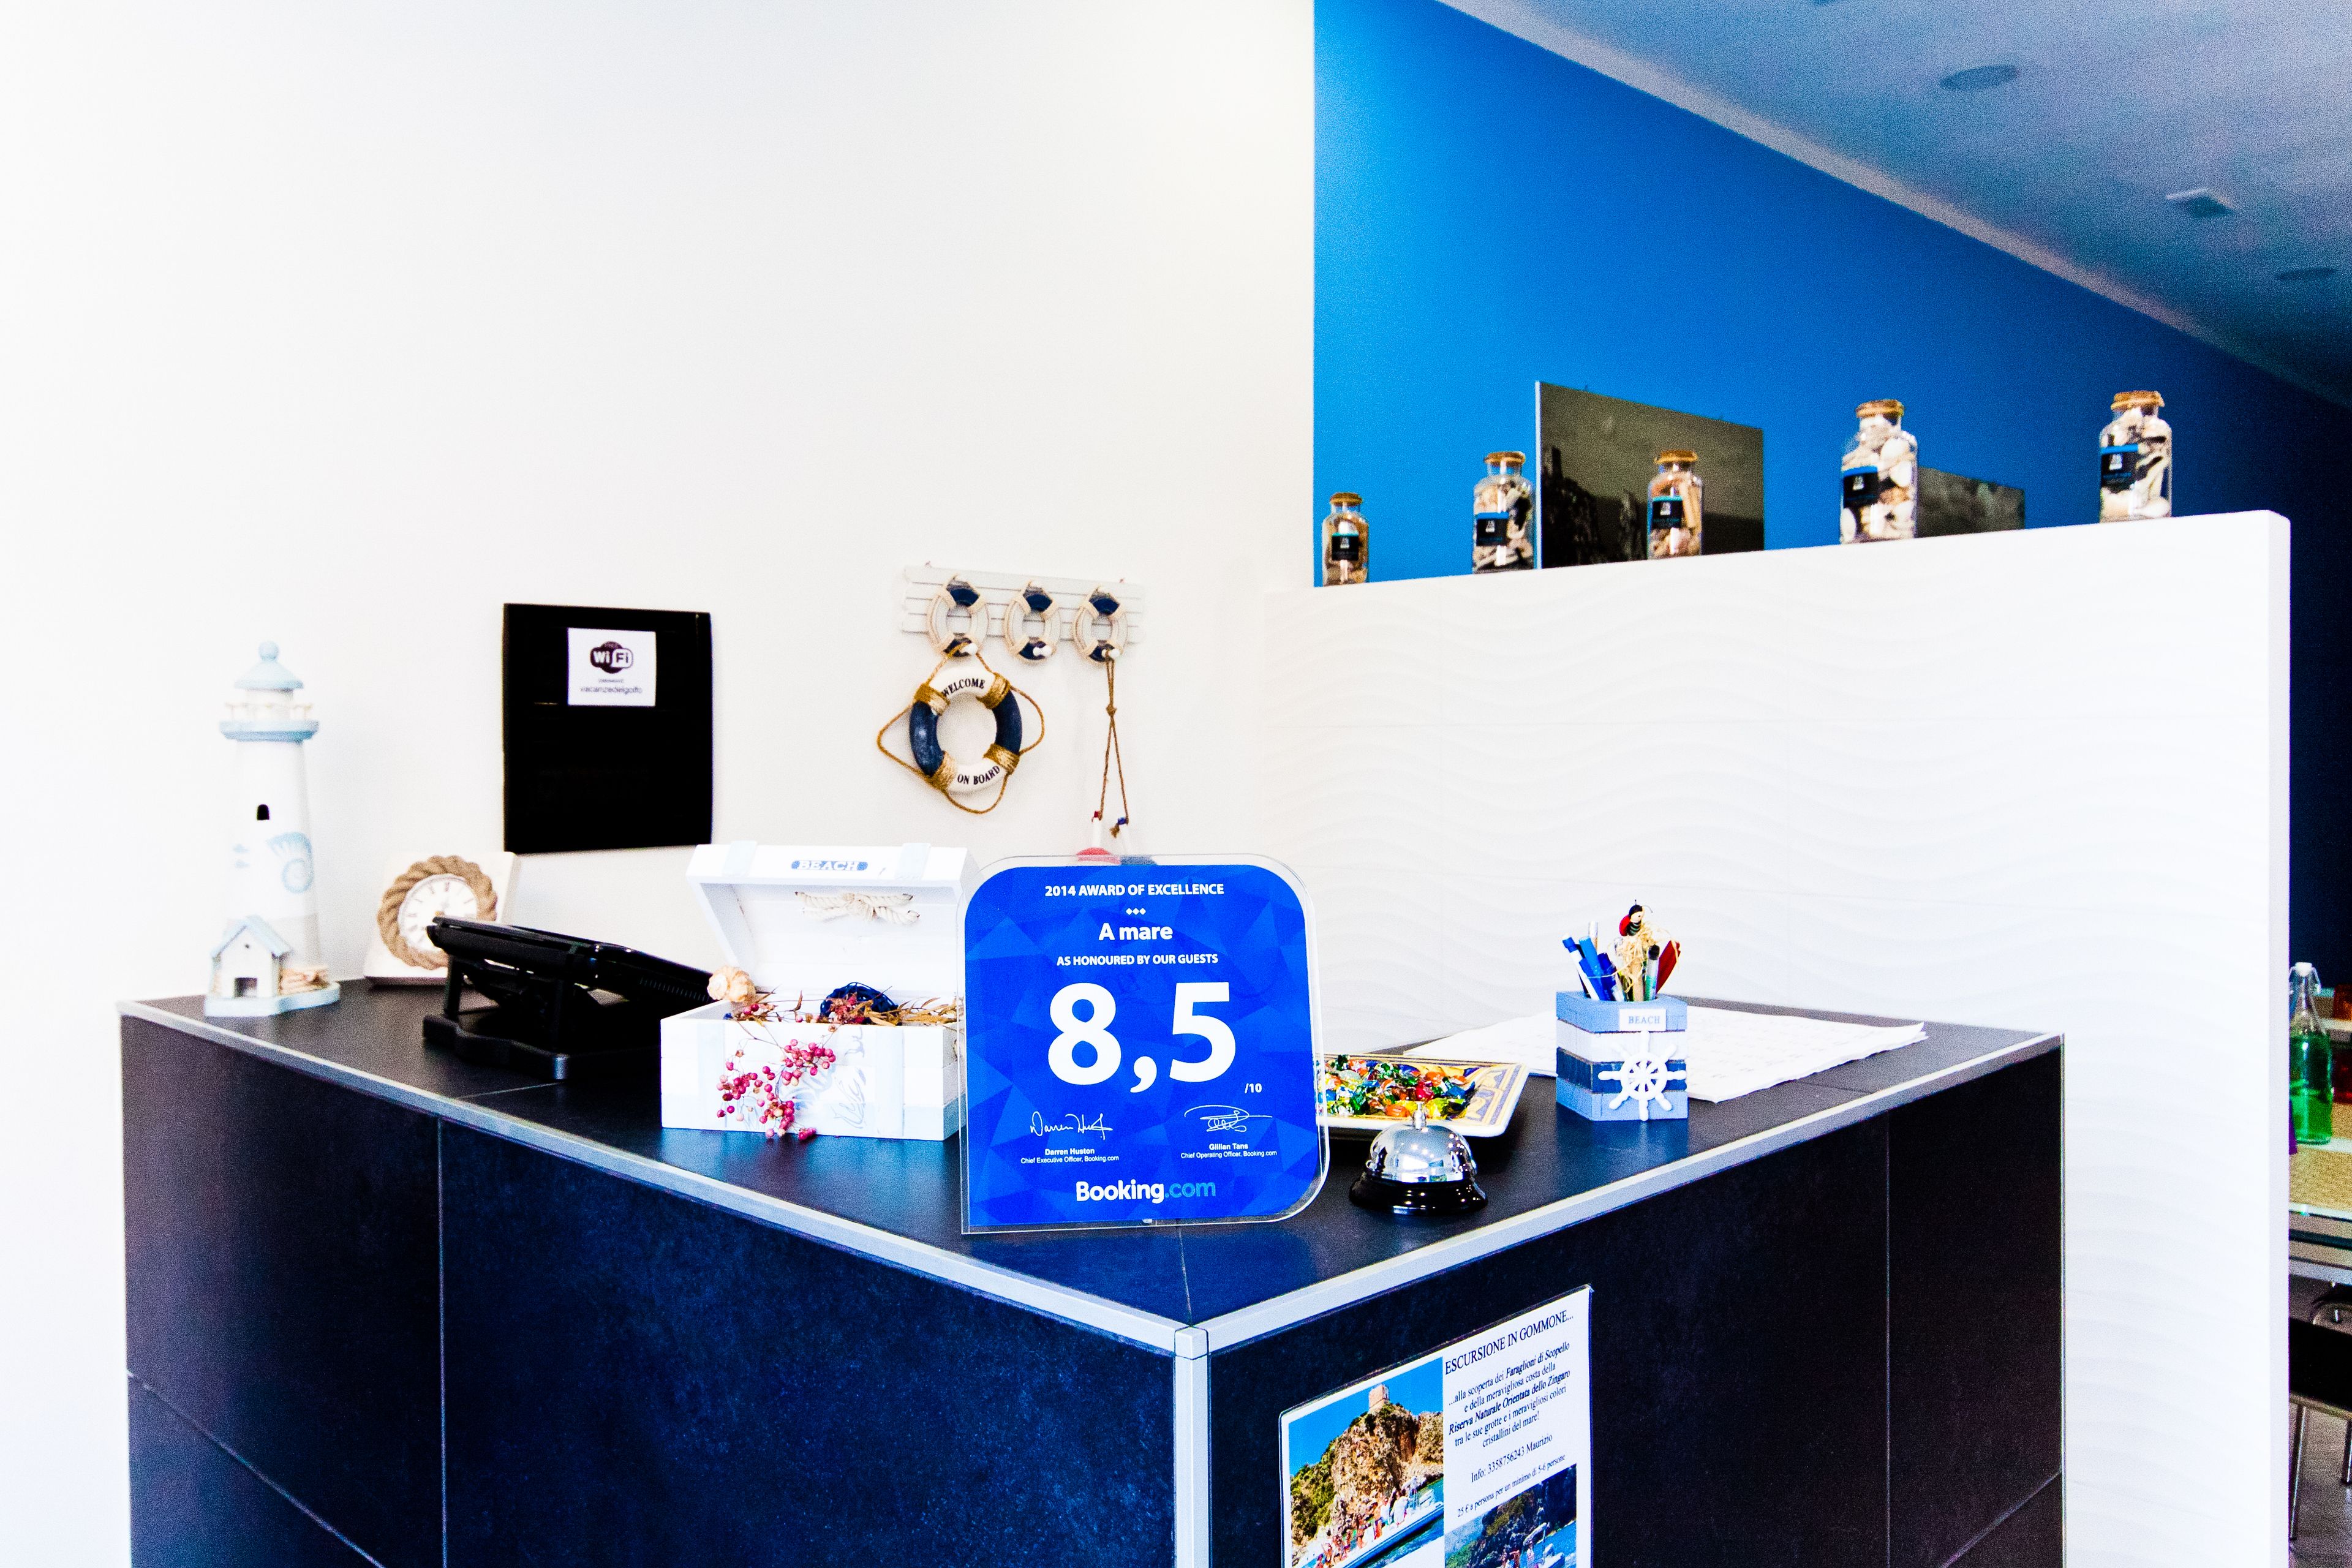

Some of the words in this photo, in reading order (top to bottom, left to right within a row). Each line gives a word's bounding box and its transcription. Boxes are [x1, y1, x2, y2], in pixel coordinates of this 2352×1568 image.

[941, 677, 986, 698] WELCOME
[957, 773, 970, 785] ON
[973, 766, 1001, 785] BOARD
[797, 860, 859, 871] BEACH
[1045, 885, 1076, 897] 2014
[1078, 884, 1125, 897] AWARD
[1128, 884, 1145, 895] OF
[1148, 883, 1224, 895] EXCELLENCE
[1098, 922, 1115, 940] A
[1119, 925, 1173, 940] mare
[1057, 956, 1071, 966] AS
[1073, 955, 1134, 965] HONOURED
[1137, 954, 1150, 965] BY
[1152, 954, 1176, 964] OUR
[1177, 954, 1219, 964] GUESTS
[1627, 1016, 1660, 1025] BEACH
[1048, 981, 1236, 1093] 8,5
[1244, 1082, 1262, 1094] /10
[1076, 1178, 1216, 1204] Booking.com
[1446, 1337, 1506, 1374] ESCURSIONE
[1508, 1331, 1517, 1346] IN
[1468, 1380, 1493, 1397] scoperta
[1494, 1371, 1504, 1382] dei
[1506, 1355, 1536, 1378] Faraglioni
[1537, 1352, 1544, 1363] di
[1545, 1341, 1570, 1360] Scopello
[1469, 1395, 1485, 1409] della
[1487, 1376, 1524, 1401] meravigliosa
[1526, 1370, 1540, 1382] costa
[1542, 1362, 1556, 1376] della
[1449, 1417, 1473, 1435] Riserva
[1475, 1402, 1501, 1422] Naturale
[1502, 1388, 1530, 1408] Orientata
[1531, 1380, 1547, 1394] dello
[1548, 1369, 1570, 1387] Zingaro
[1455, 1438, 1463, 1447] tra
[1466, 1432, 1471, 1441] le
[1472, 1428, 1483, 1438] sue
[1485, 1417, 1502, 1434] grotte
[1513, 1393, 1548, 1417] meravigliosi
[1550, 1386, 1567, 1400] colori
[1482, 1428, 1510, 1447] cristallini
[1512, 1421, 1521, 1432] del
[1523, 1410, 1539, 1428] mare!
[1471, 1468, 1487, 1483] Info:
[1526, 1434, 1553, 1453] Maurizio
[1474, 1493, 1494, 1510] persona
[1495, 1488, 1504, 1500] per
[1512, 1471, 1531, 1488] minimo
[1547, 1454, 1566, 1469] persone
